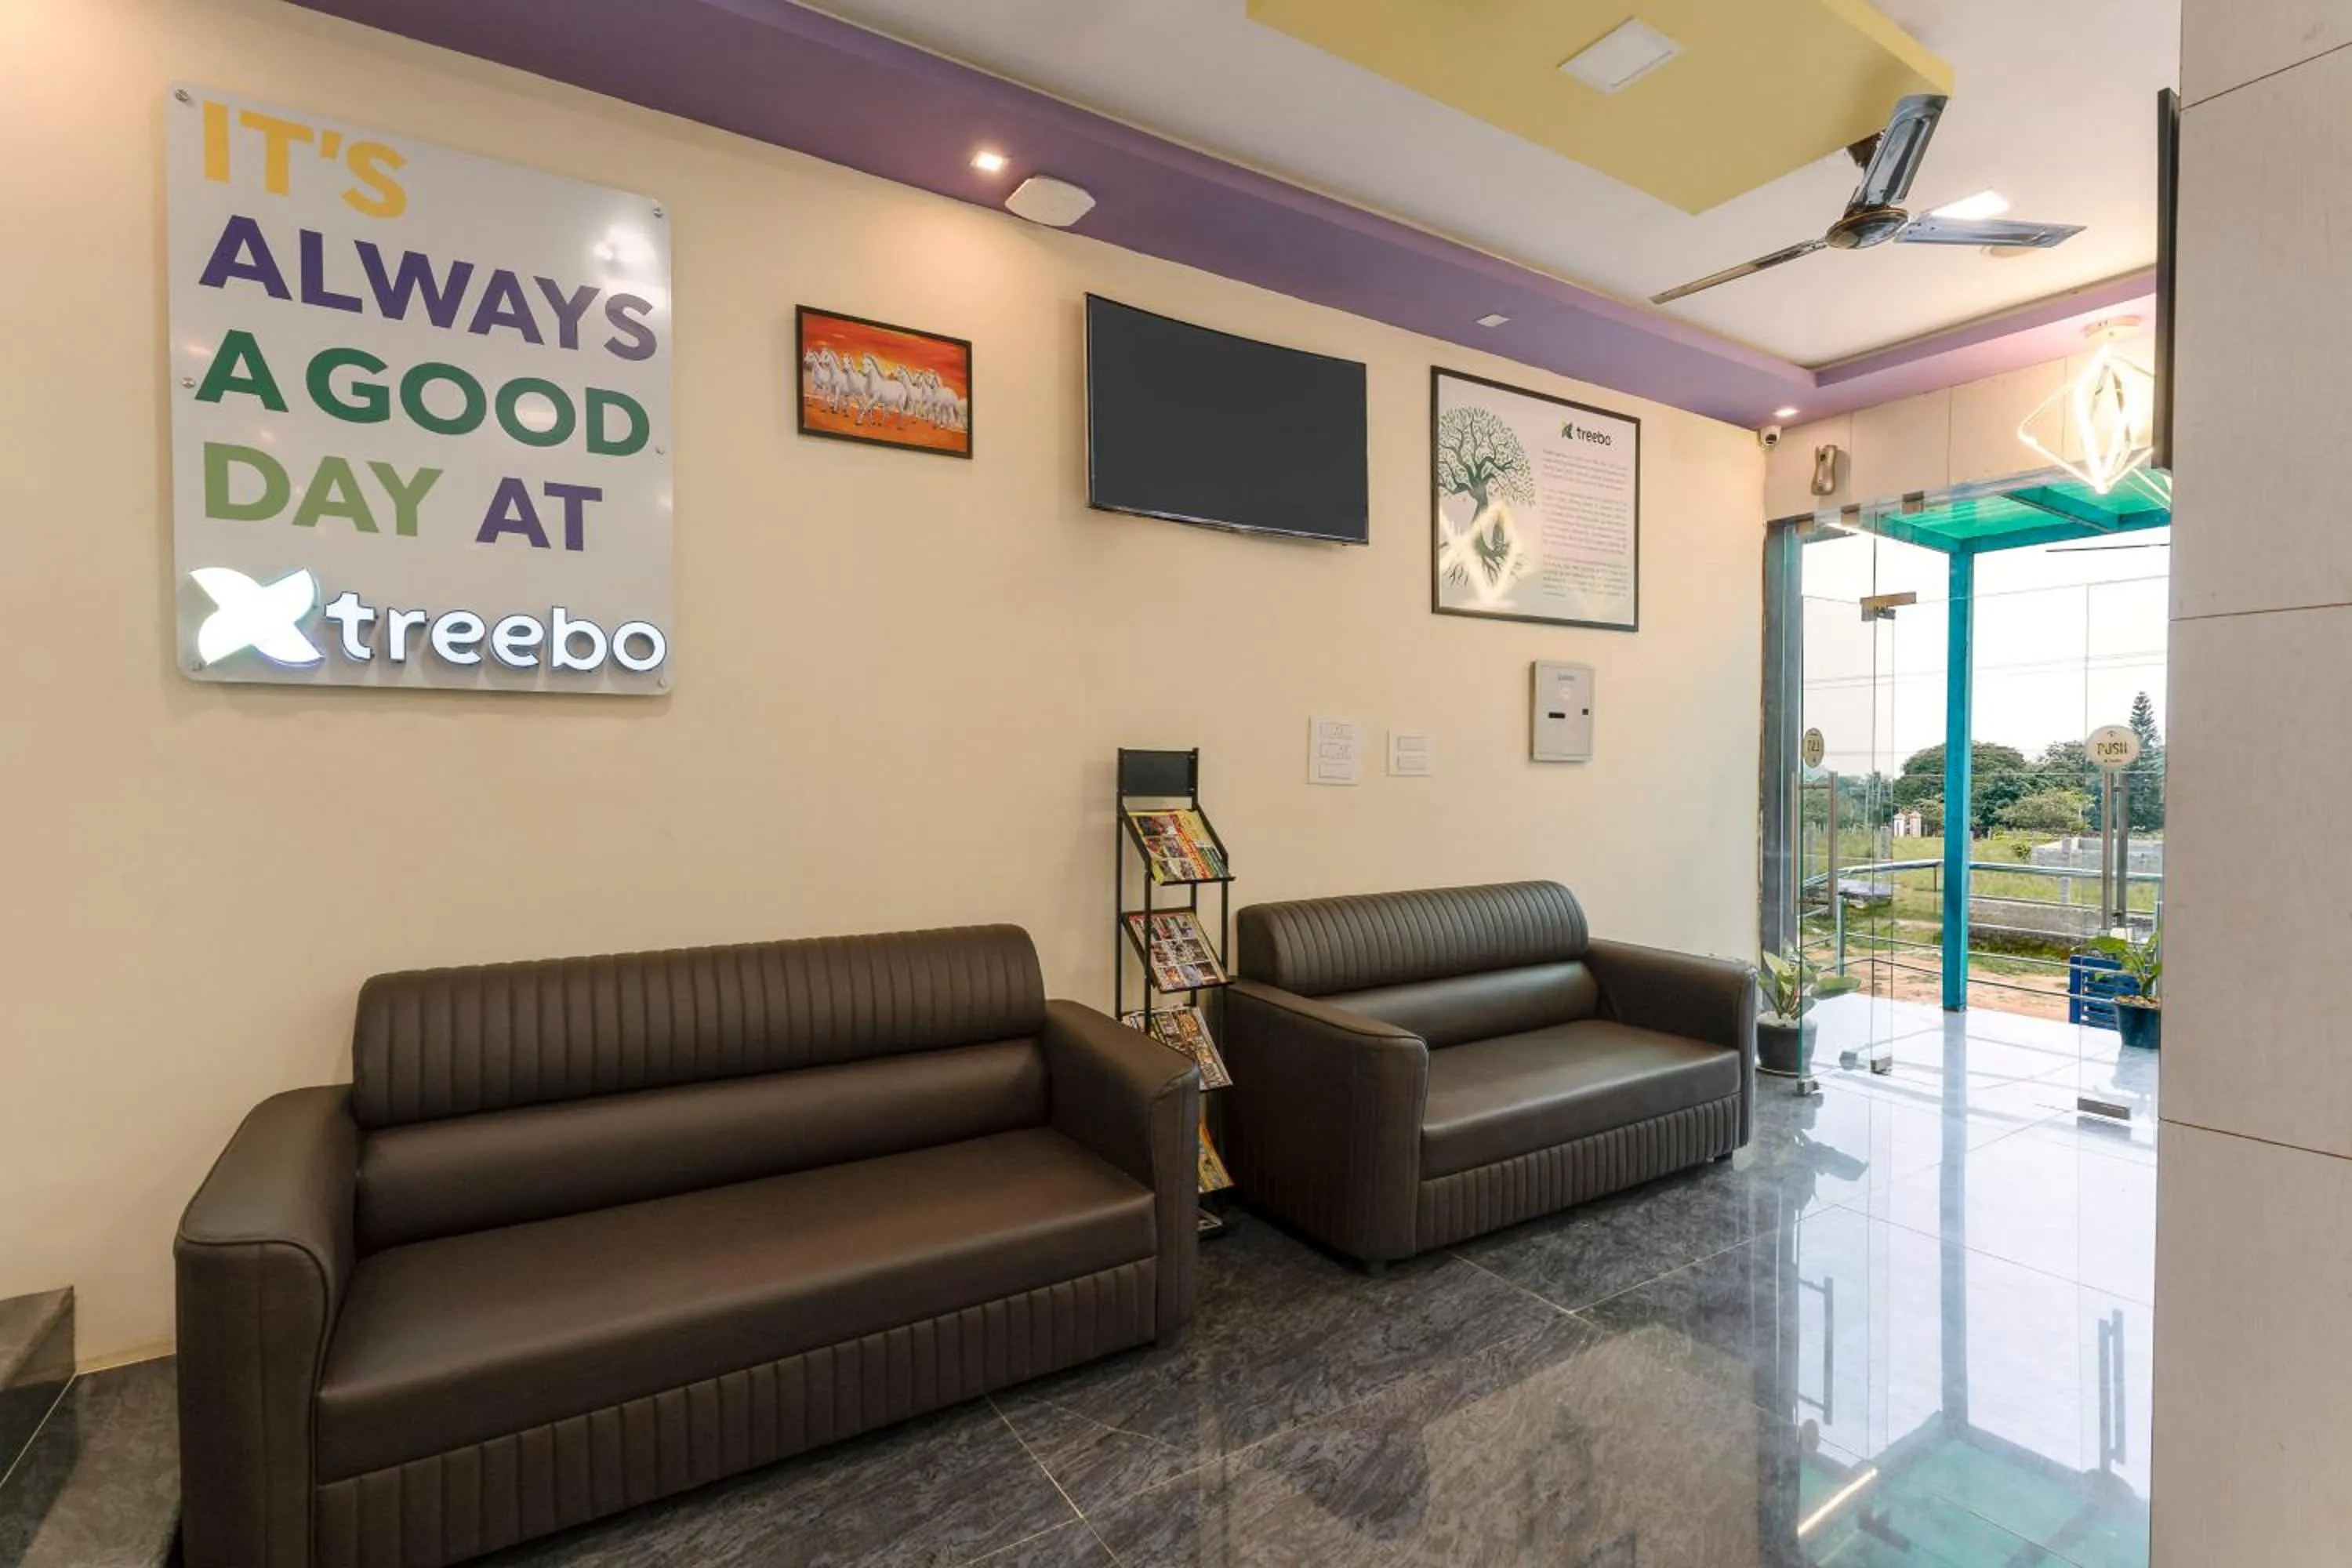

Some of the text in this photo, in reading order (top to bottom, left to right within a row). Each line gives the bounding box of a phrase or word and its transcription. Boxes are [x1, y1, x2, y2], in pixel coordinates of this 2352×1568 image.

[201, 100, 408, 219] IT'S
[198, 214, 658, 361] ALWAYS
[194, 328, 650, 456] A GOOD
[1576, 426, 1611, 445] treebo
[203, 441, 603, 551] DAY AT
[325, 591, 667, 672] treebo
